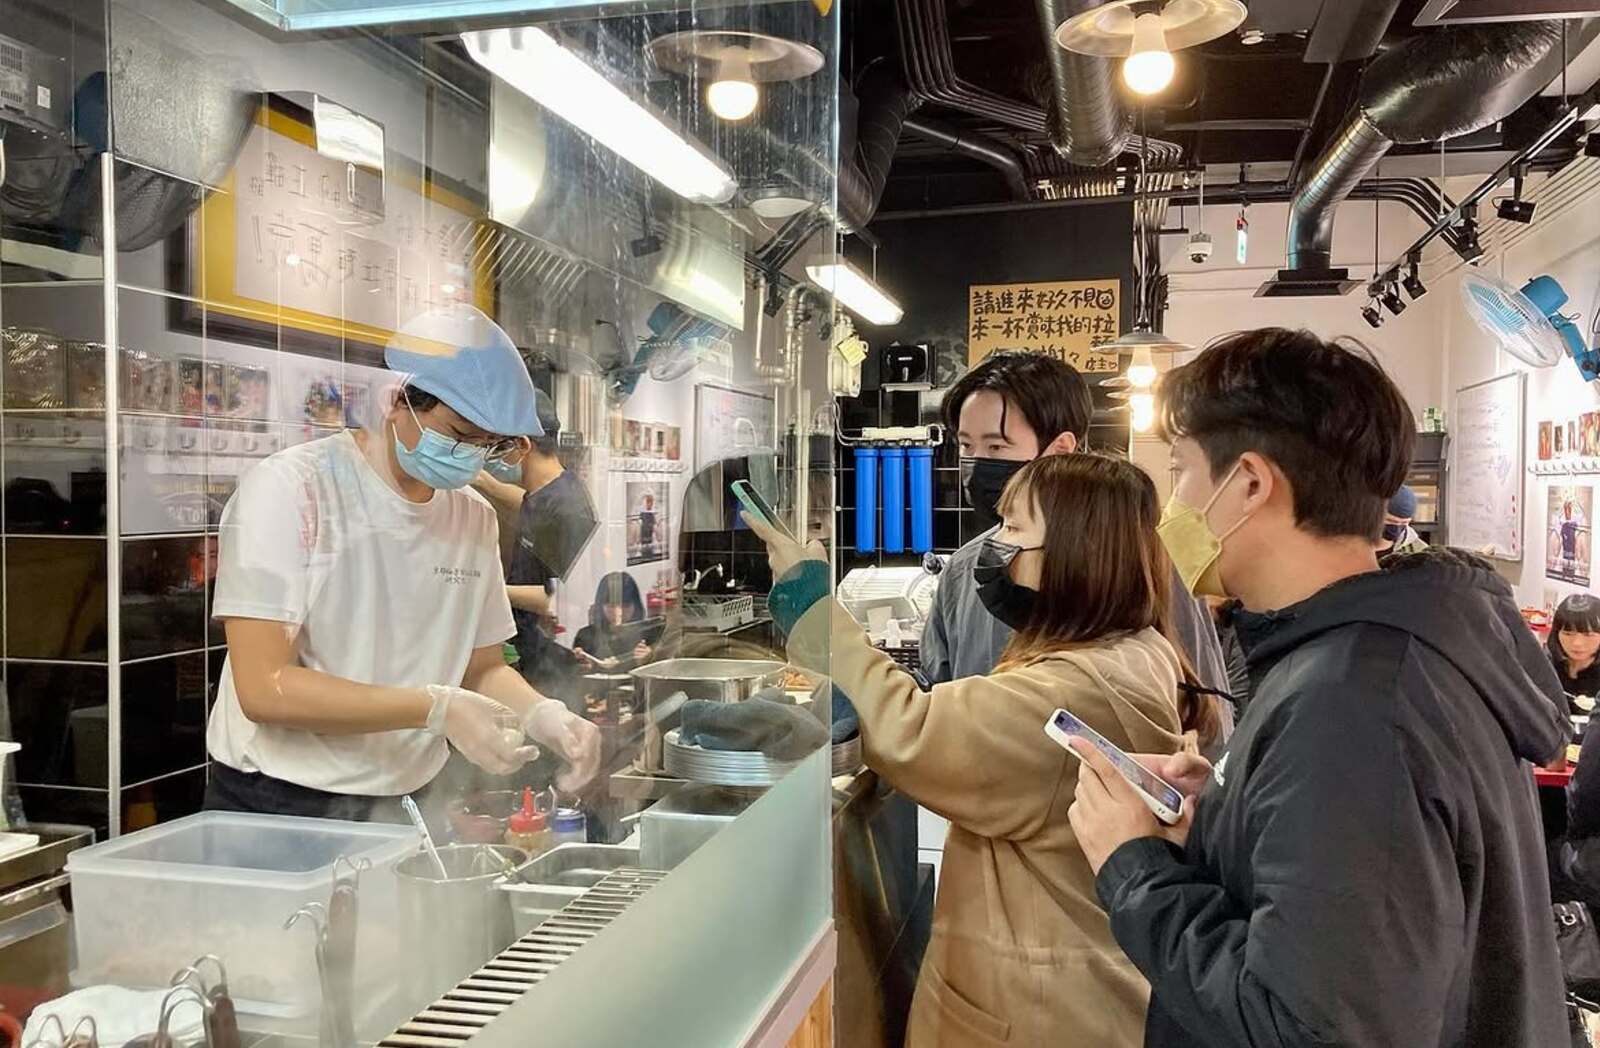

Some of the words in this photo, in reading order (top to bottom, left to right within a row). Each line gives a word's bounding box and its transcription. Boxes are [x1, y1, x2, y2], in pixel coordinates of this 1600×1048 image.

[973, 287, 1096, 315] 請進來好久不見
